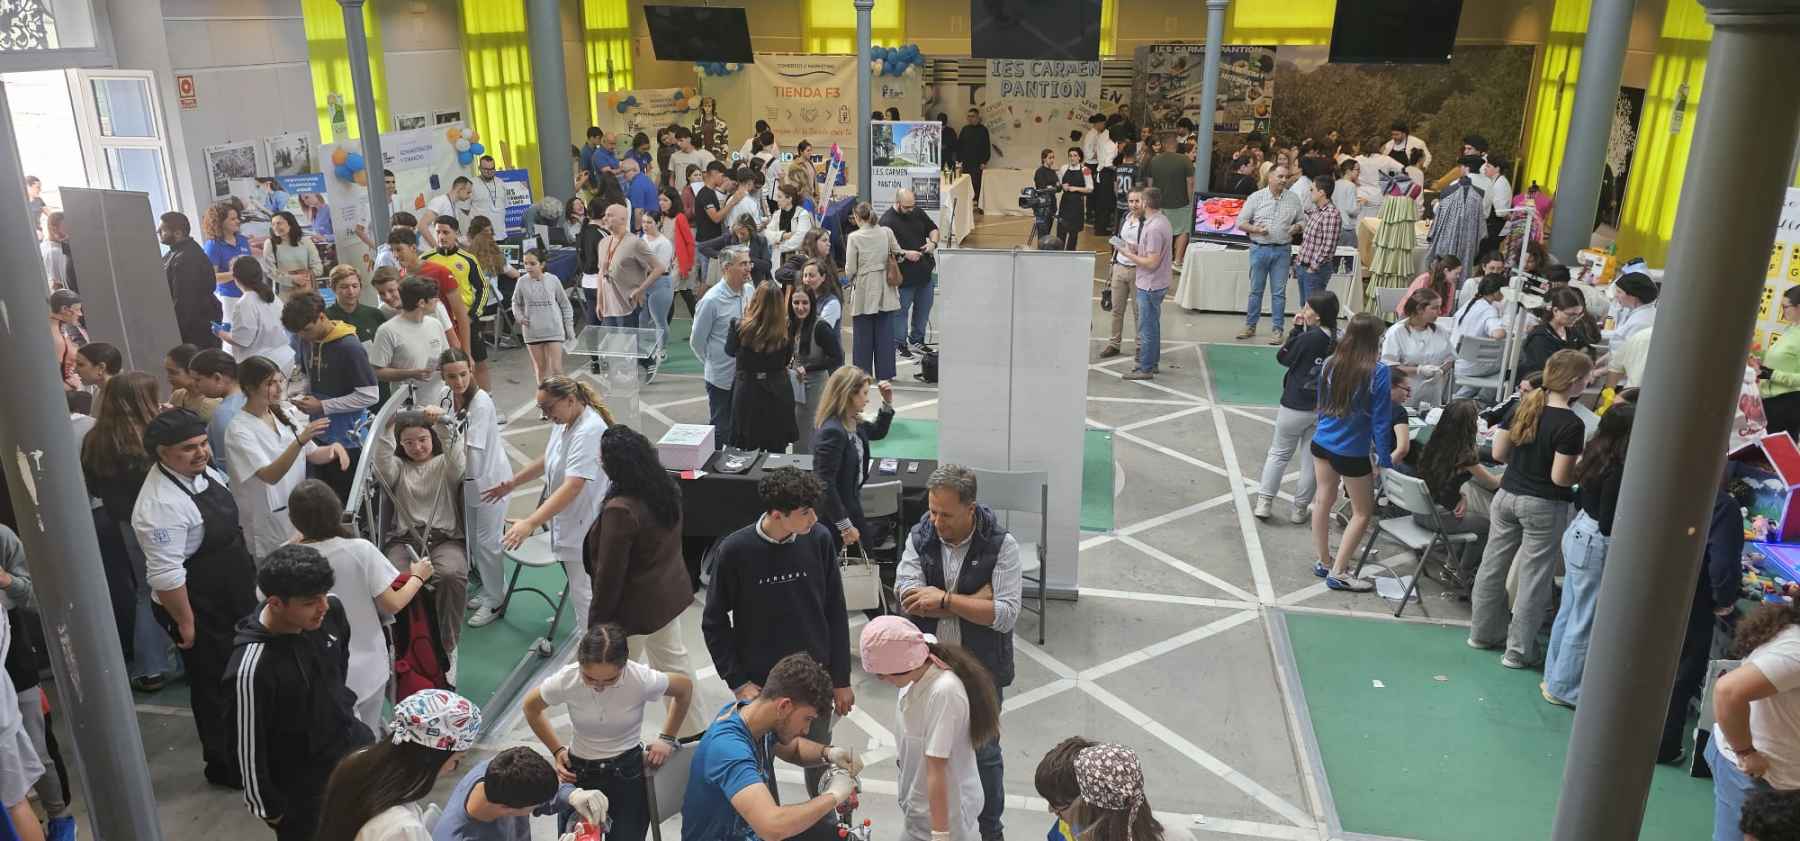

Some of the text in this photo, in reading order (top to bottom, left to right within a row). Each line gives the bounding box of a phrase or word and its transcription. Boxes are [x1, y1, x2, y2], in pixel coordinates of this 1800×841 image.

[992, 60, 1101, 78] IES CARMEN
[774, 86, 841, 98] TIENDA F3
[1114, 175, 1131, 193] 20
[1791, 268, 1799, 277] G
